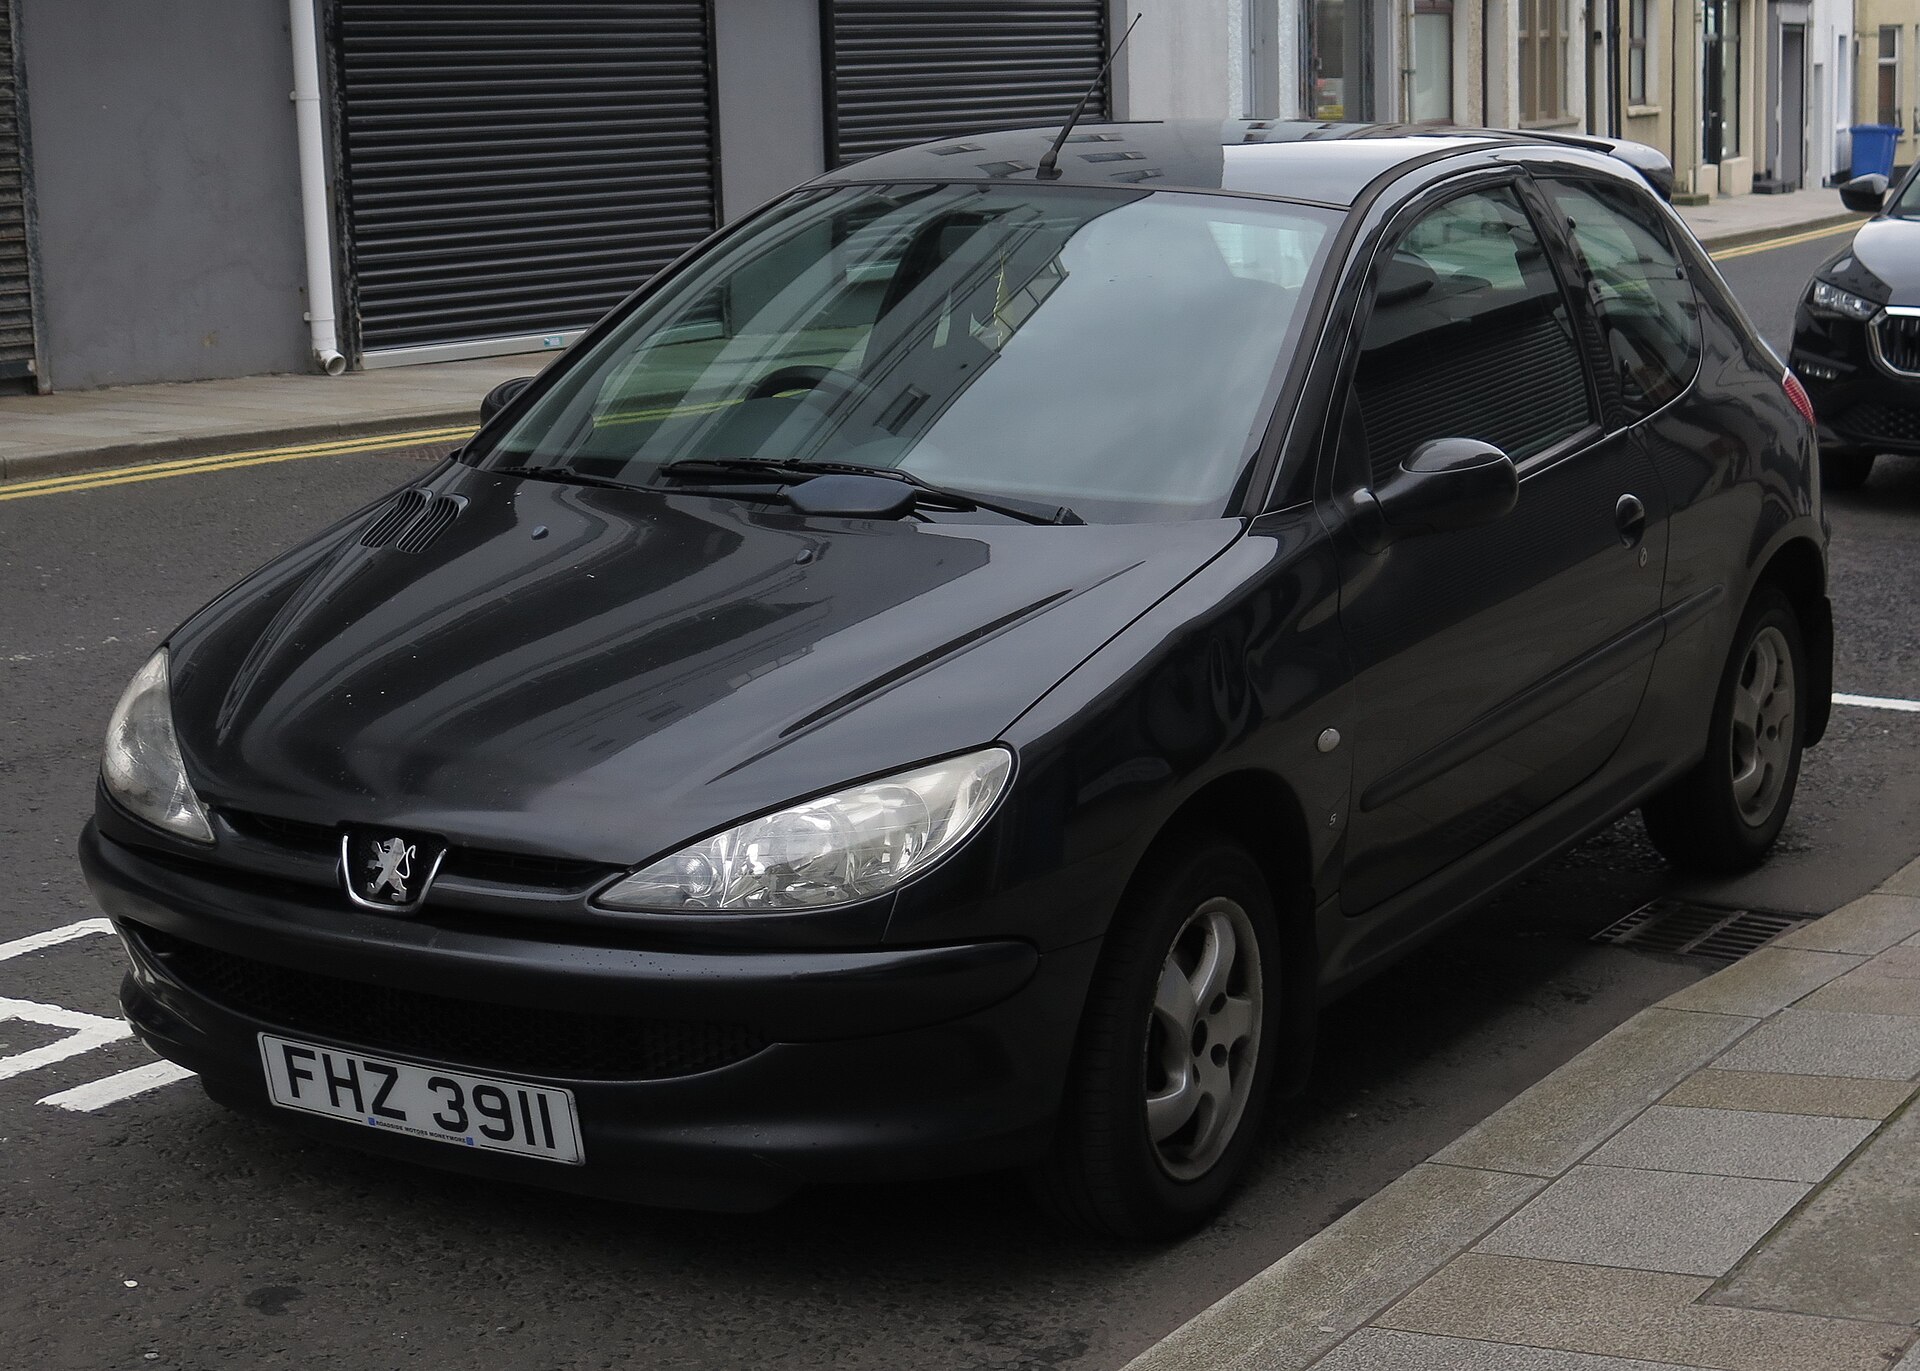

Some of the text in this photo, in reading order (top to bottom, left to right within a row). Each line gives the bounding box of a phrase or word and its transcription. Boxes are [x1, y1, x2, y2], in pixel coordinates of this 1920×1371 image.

[281, 1043, 556, 1150] FHZ 3911
[375, 1120, 466, 1143] ROADSIDE MOTORS MONEYMORE
